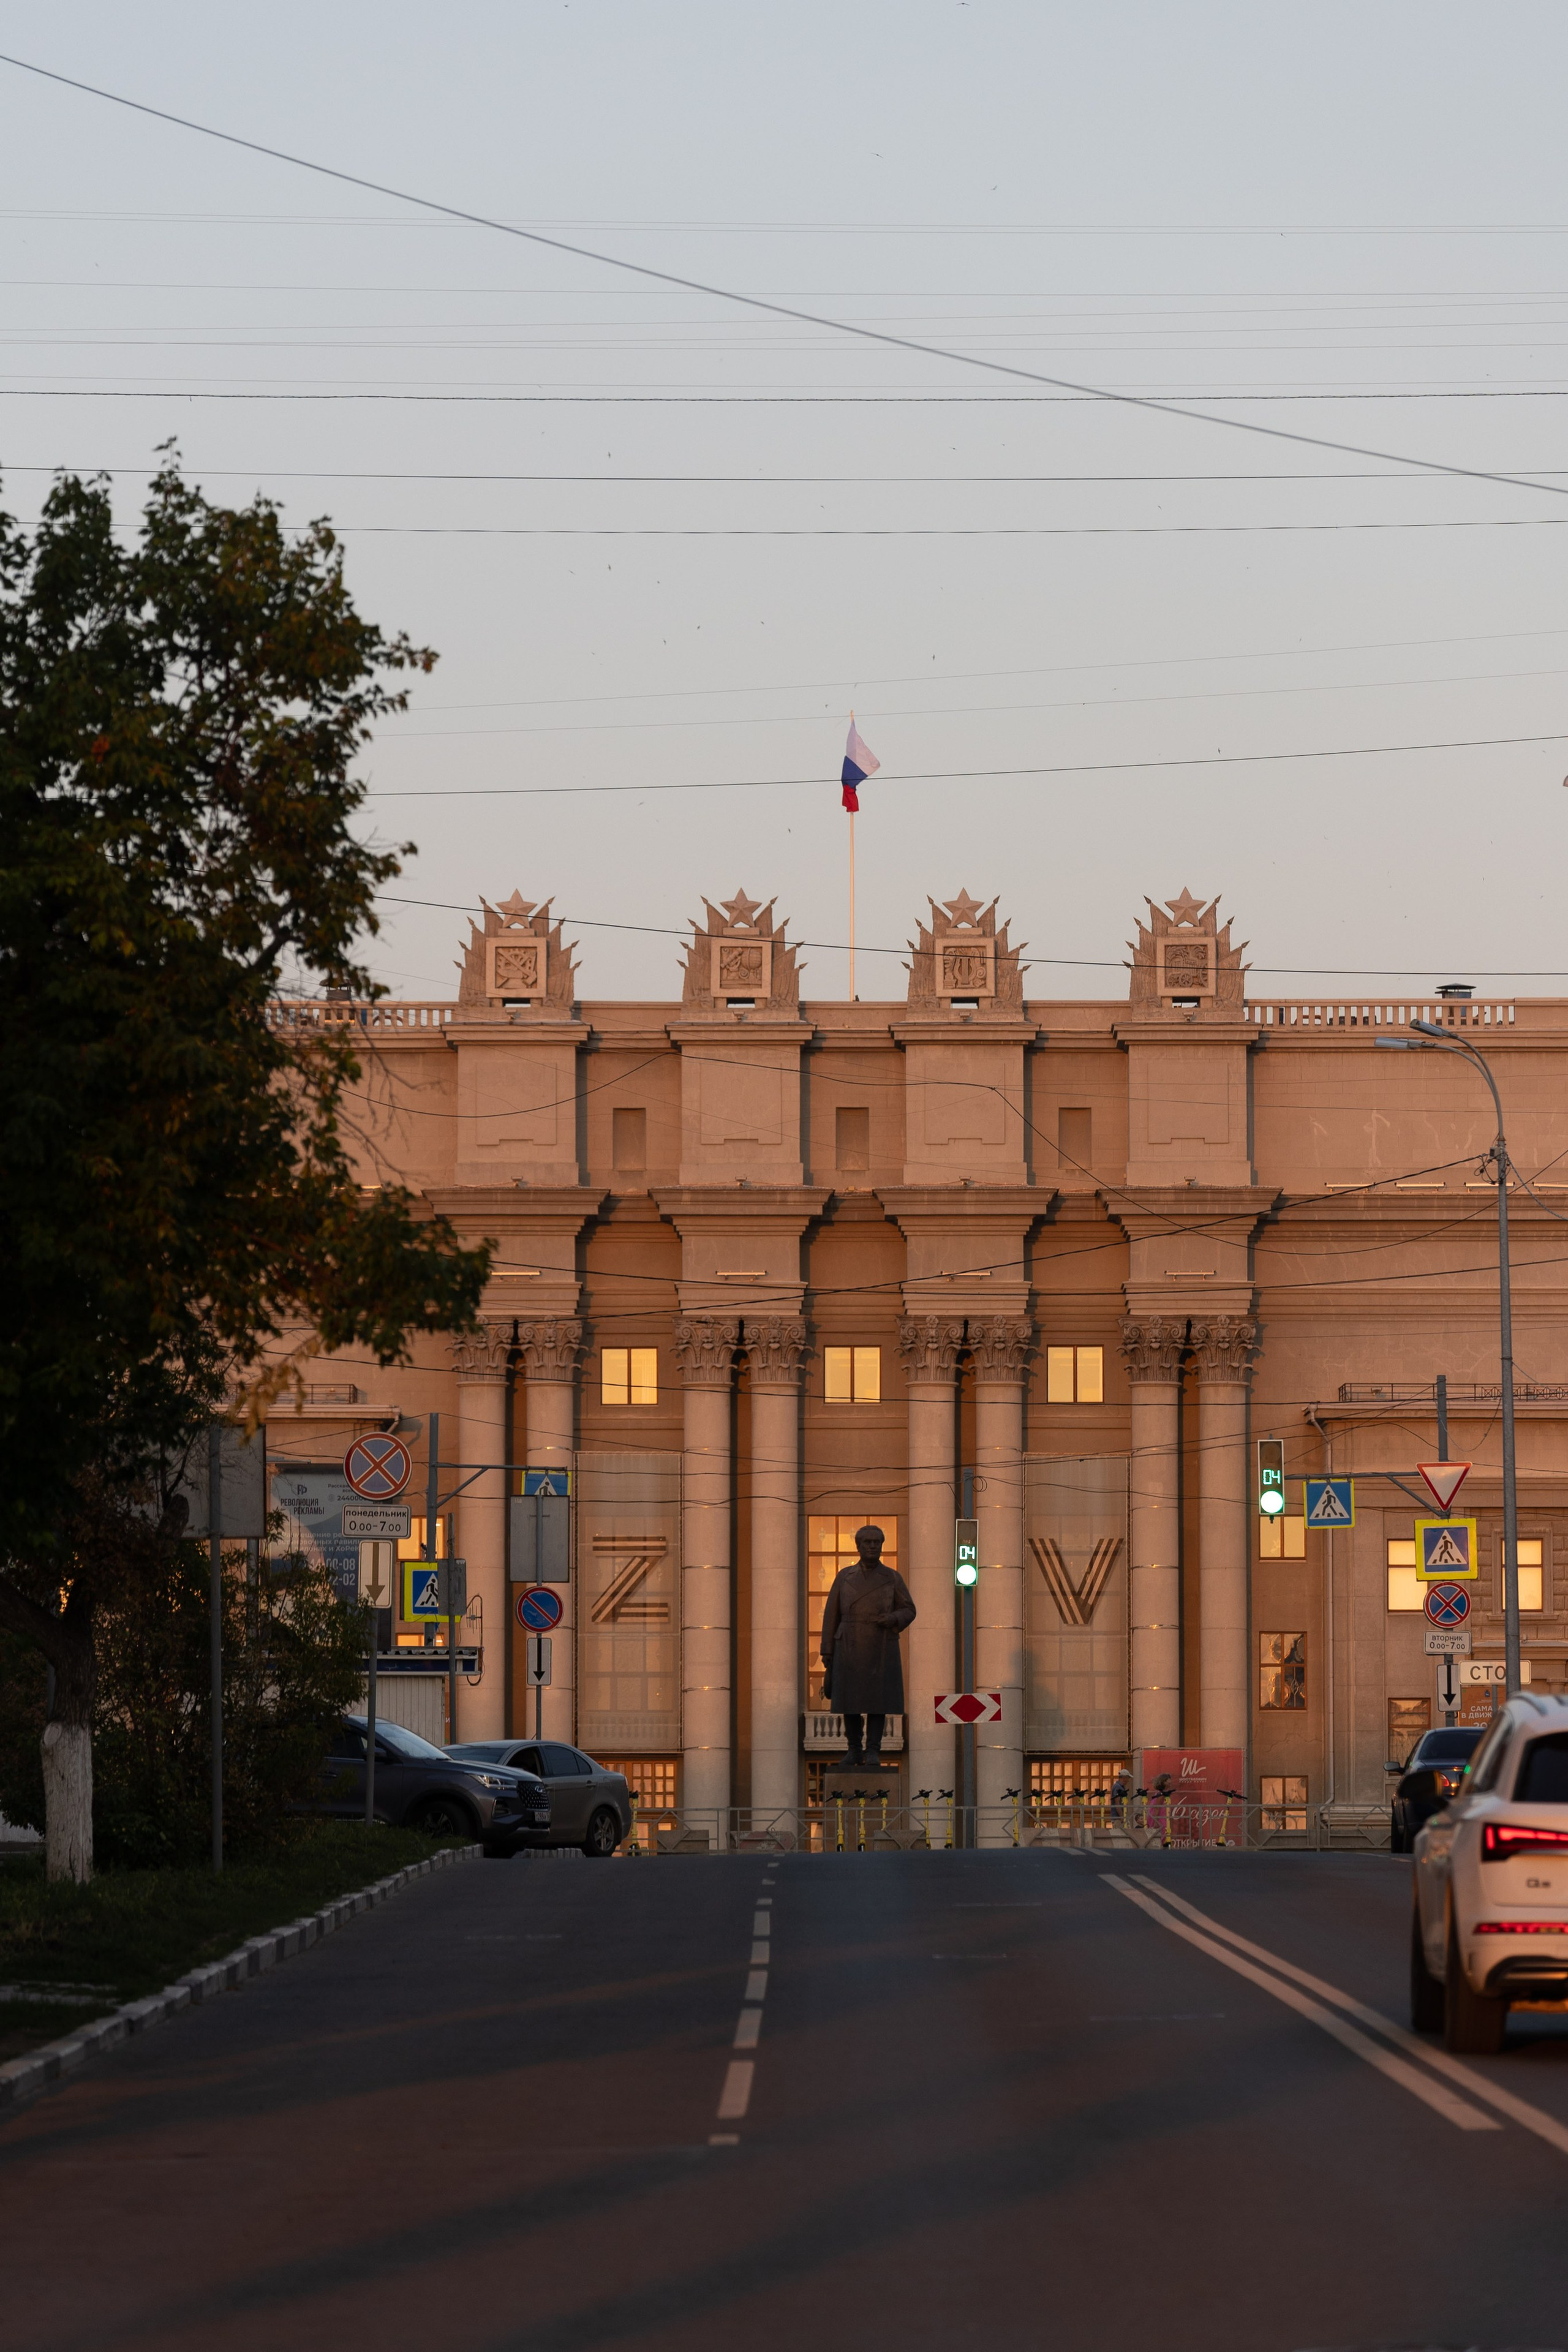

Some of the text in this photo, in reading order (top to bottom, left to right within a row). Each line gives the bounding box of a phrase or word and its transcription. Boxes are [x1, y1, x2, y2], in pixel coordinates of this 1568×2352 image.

[1263, 1469, 1281, 1485] 04
[281, 1498, 318, 1507] РЕВОЛЮЦИЯ
[349, 1520, 401, 1532] 0.00-7.00
[959, 1545, 975, 1560] 04
[1470, 1665, 1507, 1680] СТО
